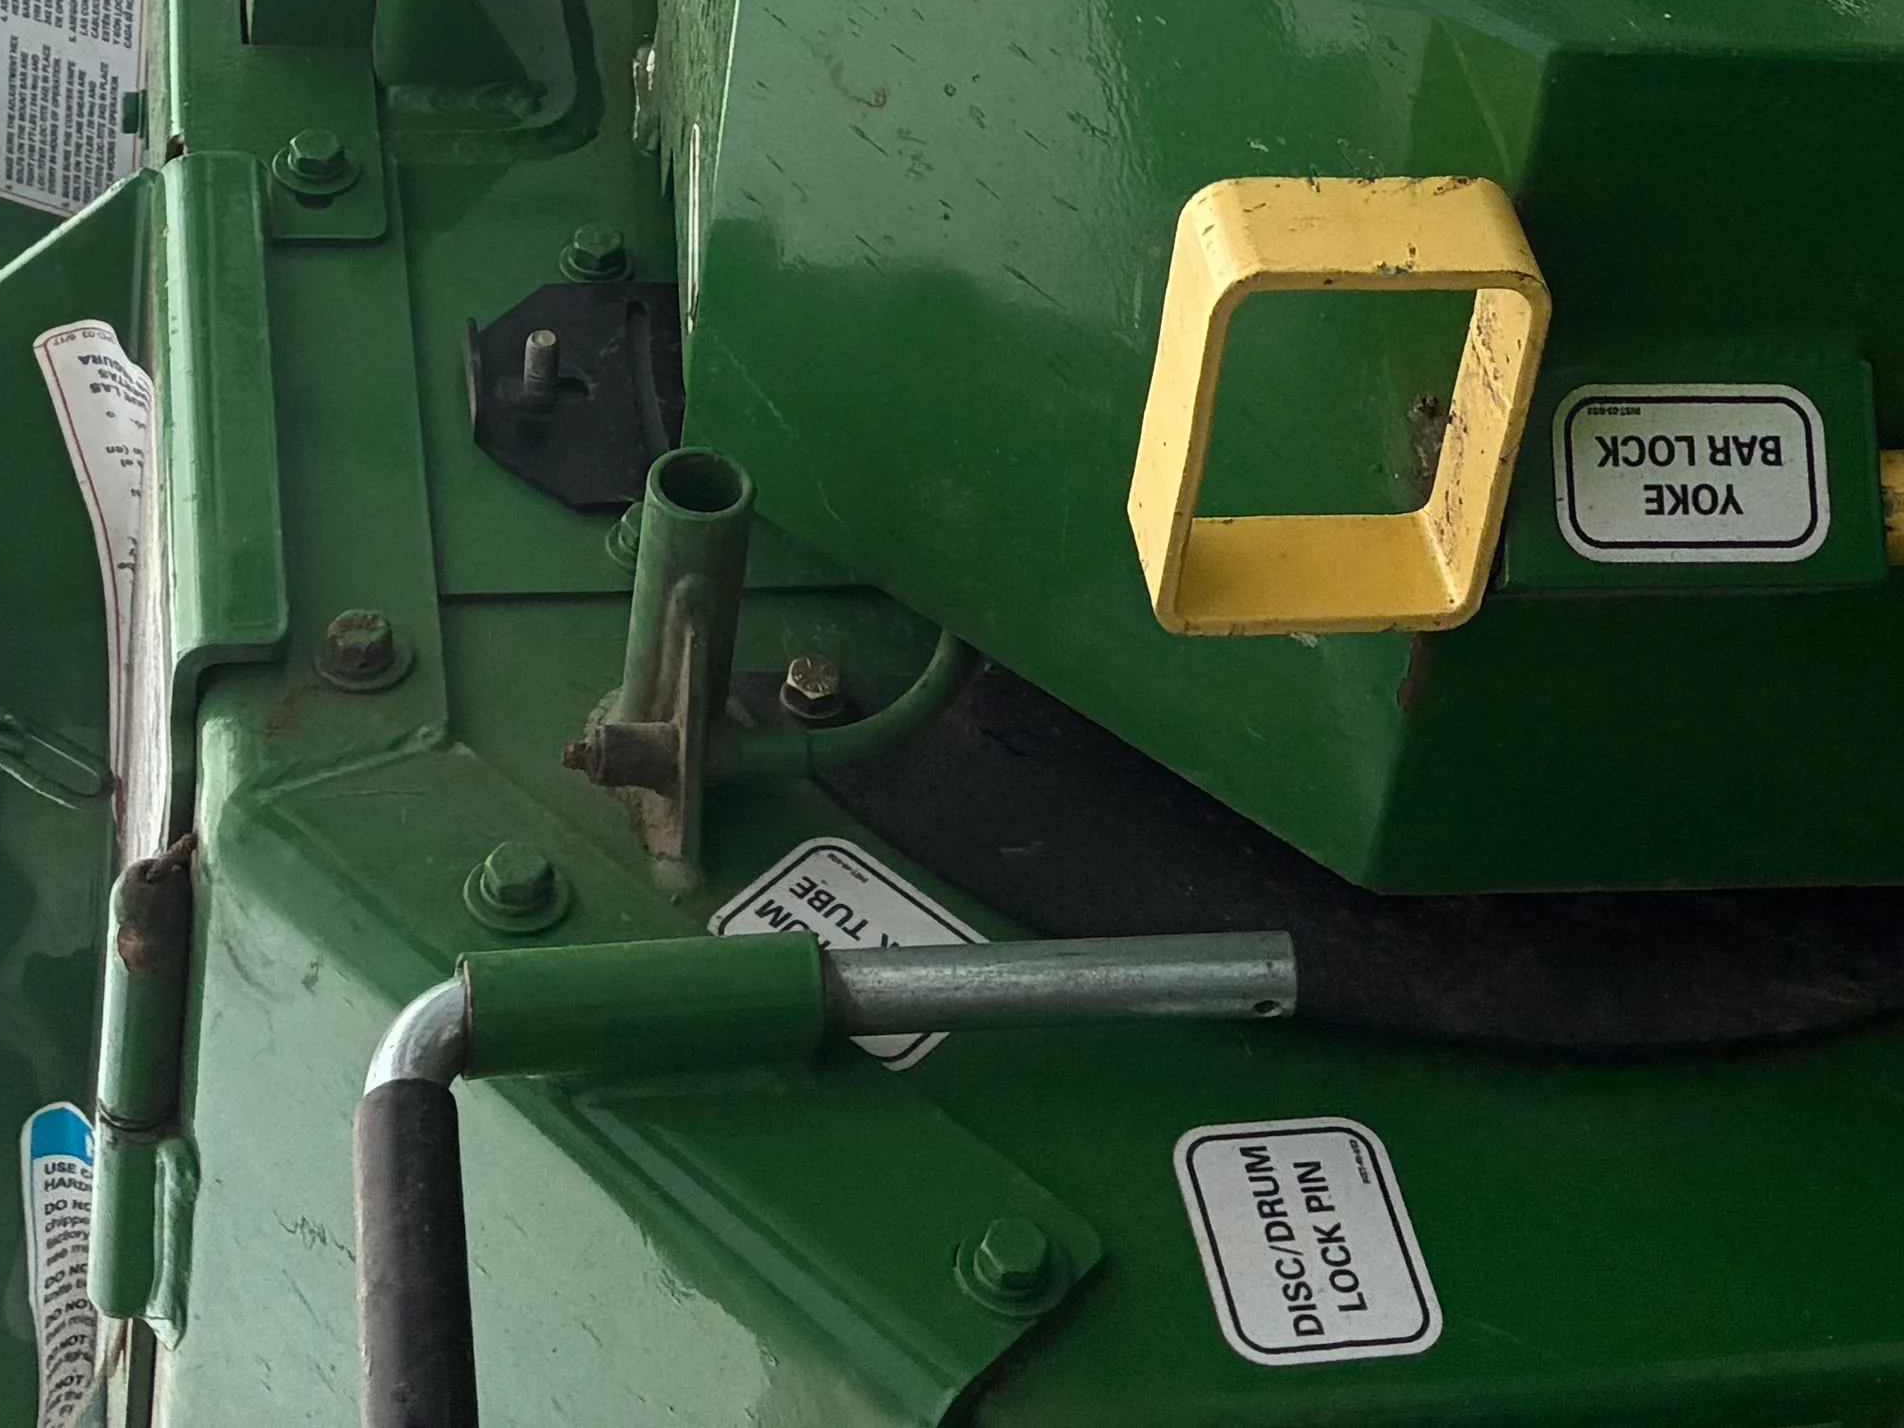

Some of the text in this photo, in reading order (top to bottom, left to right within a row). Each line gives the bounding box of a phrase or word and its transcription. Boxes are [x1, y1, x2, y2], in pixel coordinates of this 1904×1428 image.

[1594, 435, 1782, 468] BAR LOCK
[1643, 483, 1744, 516] YOKE
[788, 876, 869, 941] TUBE
[44, 1162, 77, 1175] USE
[1293, 1161, 1336, 1213] PIN
[1239, 1145, 1325, 1337] DISC/DRUM
[1312, 1222, 1368, 1312] LOCK
